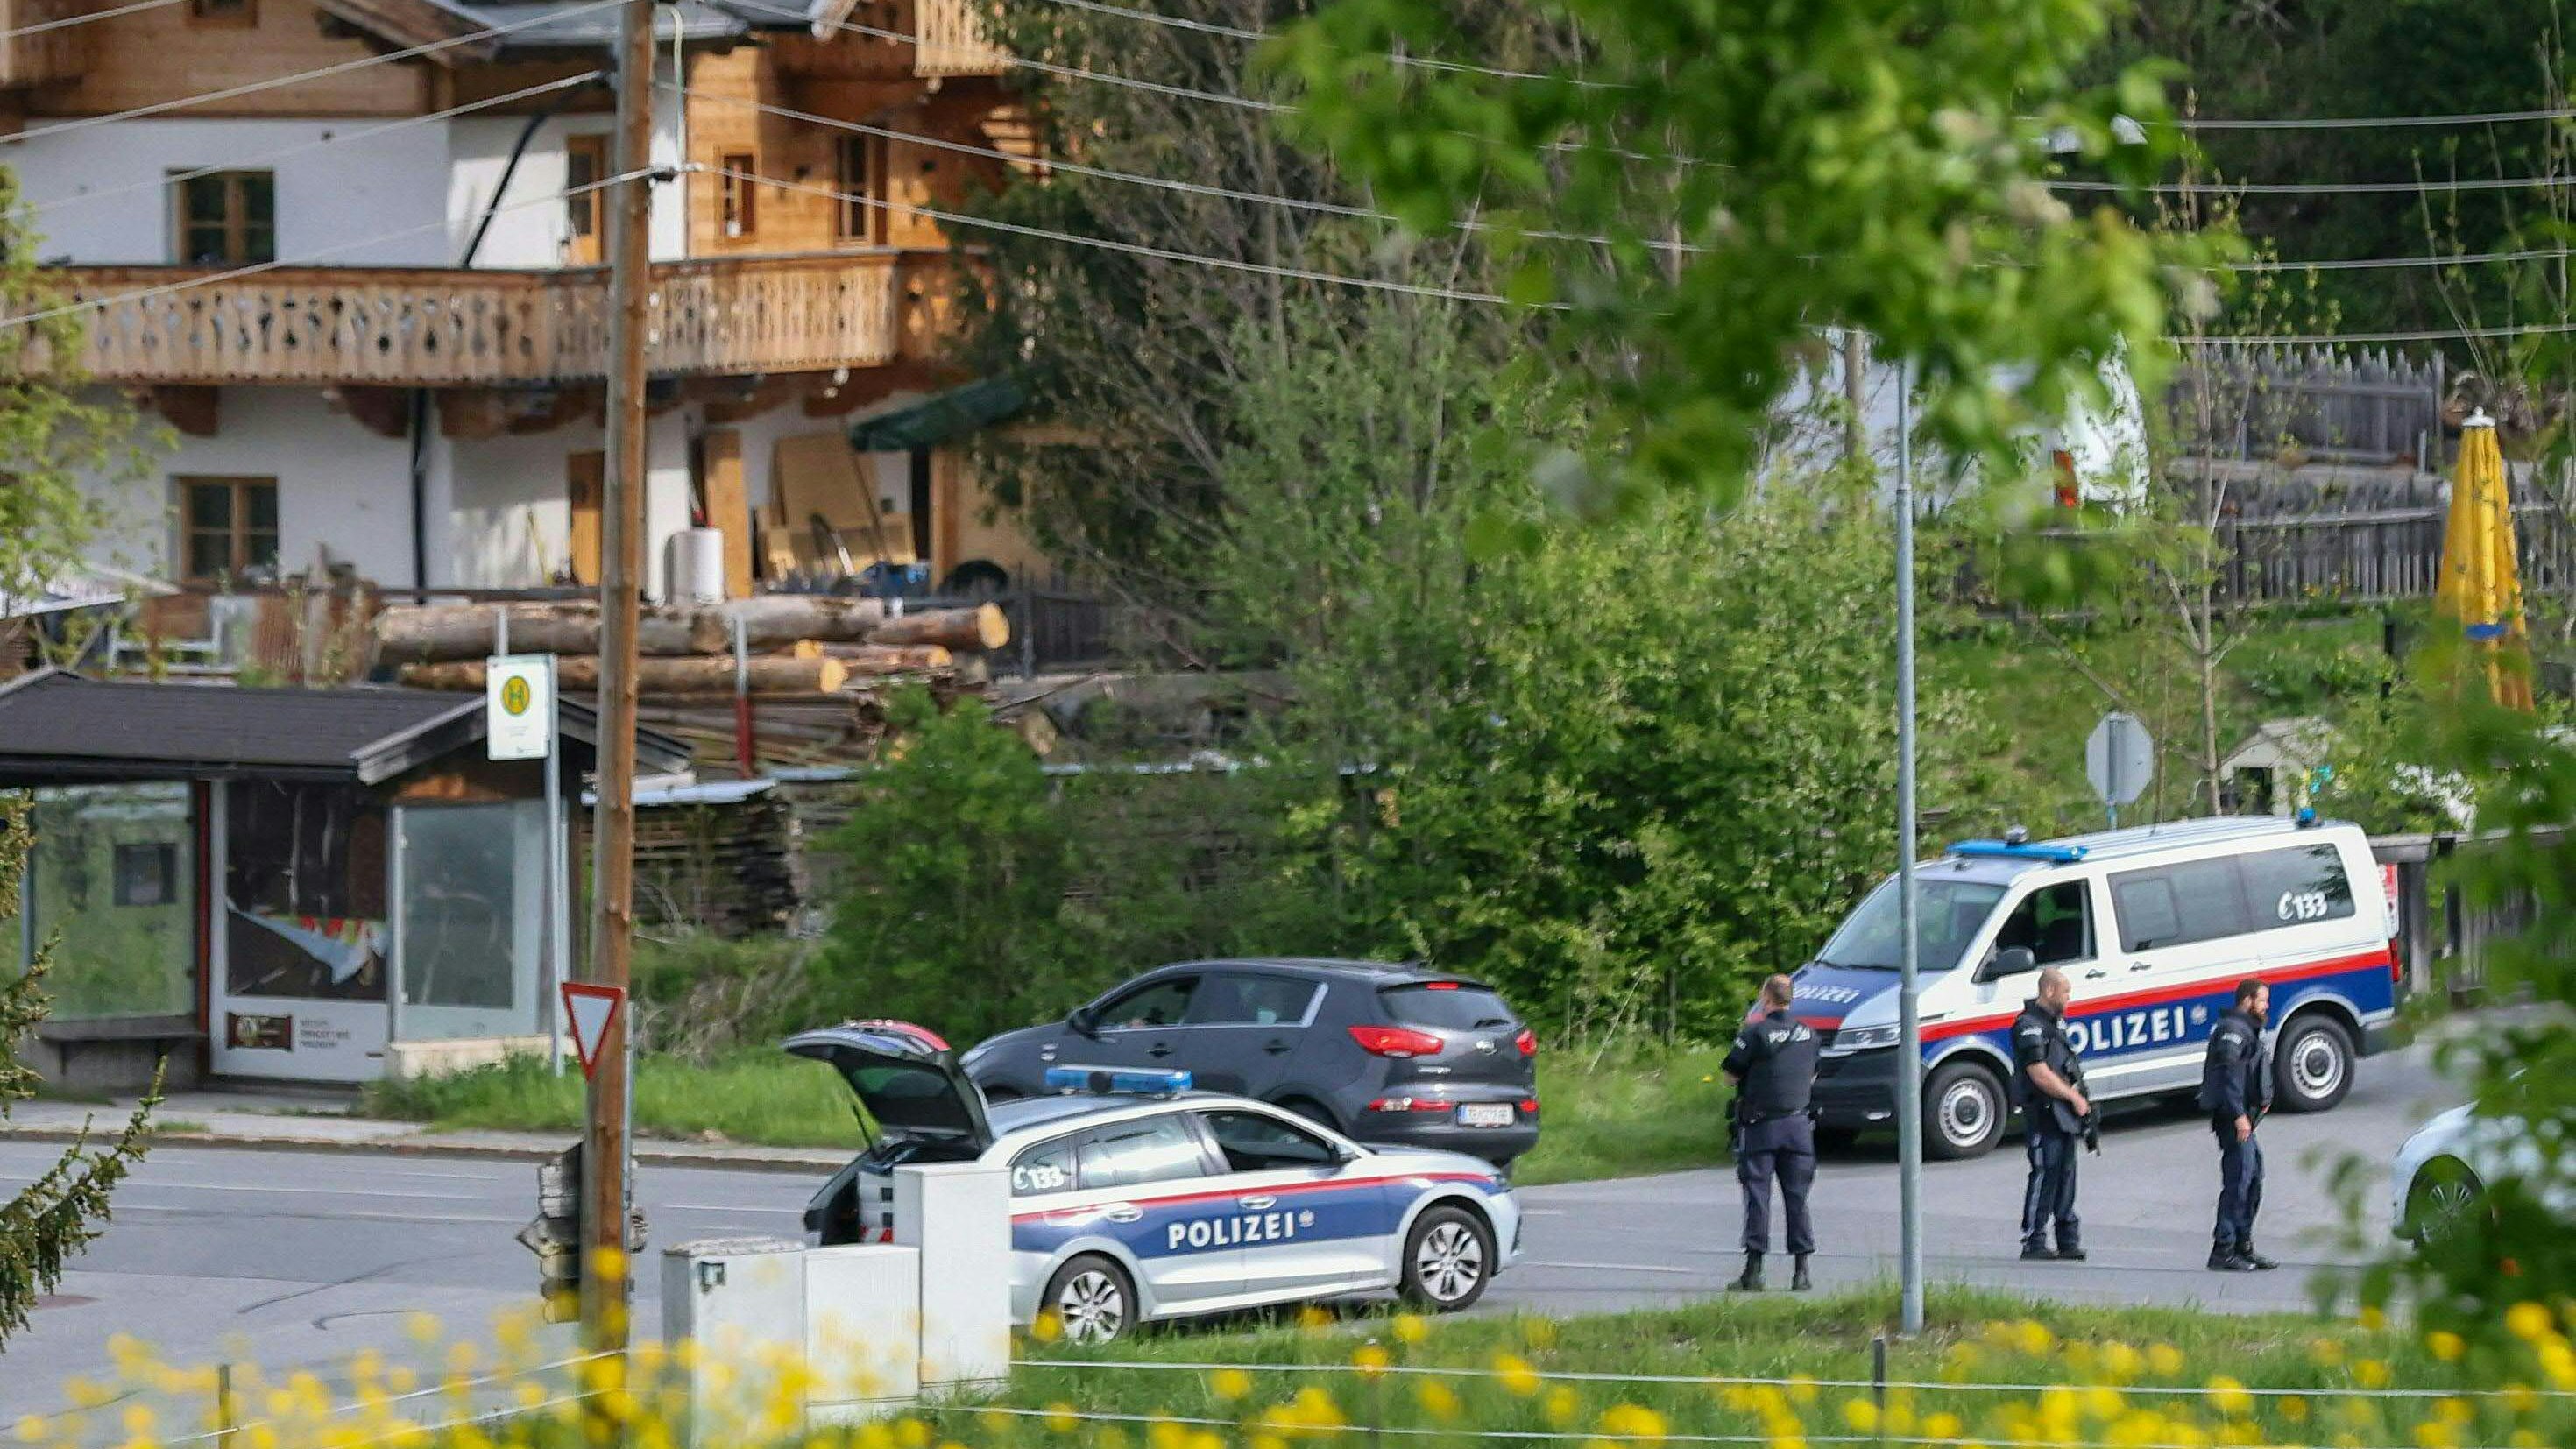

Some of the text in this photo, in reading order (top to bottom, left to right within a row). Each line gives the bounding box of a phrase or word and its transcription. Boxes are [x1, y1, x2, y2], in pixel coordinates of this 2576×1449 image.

[508, 684, 525, 706] H
[2292, 891, 2328, 920] 133
[1792, 985, 1861, 1004] OLIZEI
[2056, 1006, 2185, 1056] OLIZEI
[1027, 1165, 1065, 1190] 133
[1167, 1211, 1295, 1250] POLIZEI
